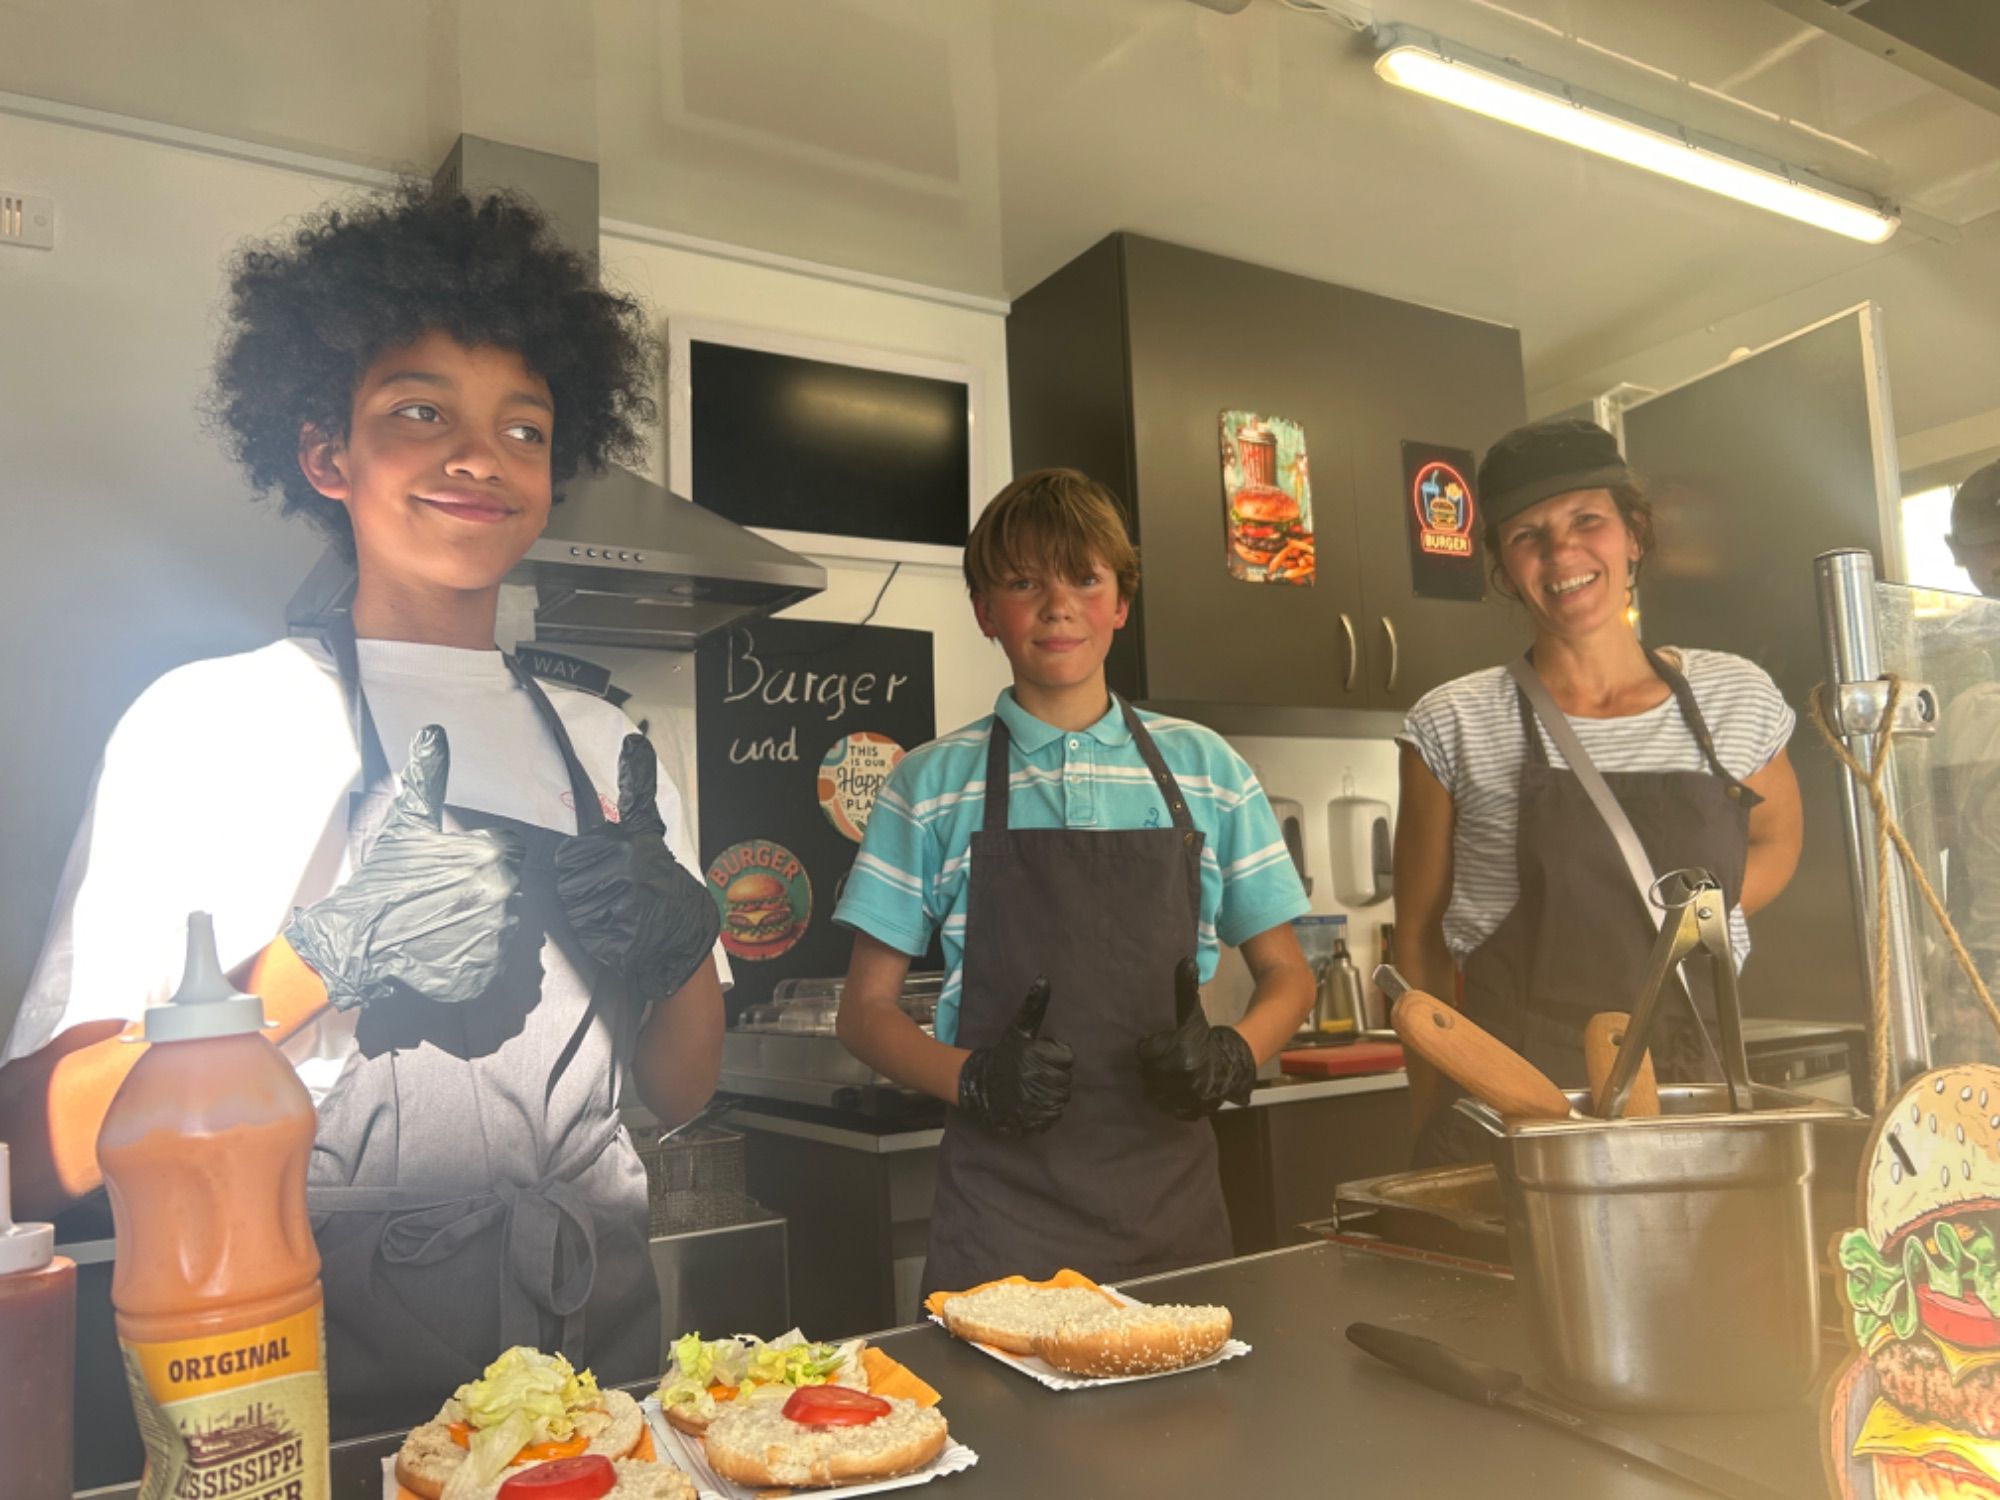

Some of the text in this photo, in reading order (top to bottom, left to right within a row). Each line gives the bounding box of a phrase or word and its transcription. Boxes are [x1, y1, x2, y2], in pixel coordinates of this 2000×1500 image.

[1424, 534, 1468, 551] BURGER
[533, 656, 582, 679] WAY
[729, 726, 799, 764] und
[849, 745, 879, 757] THIS
[851, 758, 886, 767] IS OUR
[837, 766, 886, 797] Happ
[847, 799, 873, 810] PLA
[709, 846, 800, 888] BURGER
[168, 1336, 291, 1384] ORIGINAL
